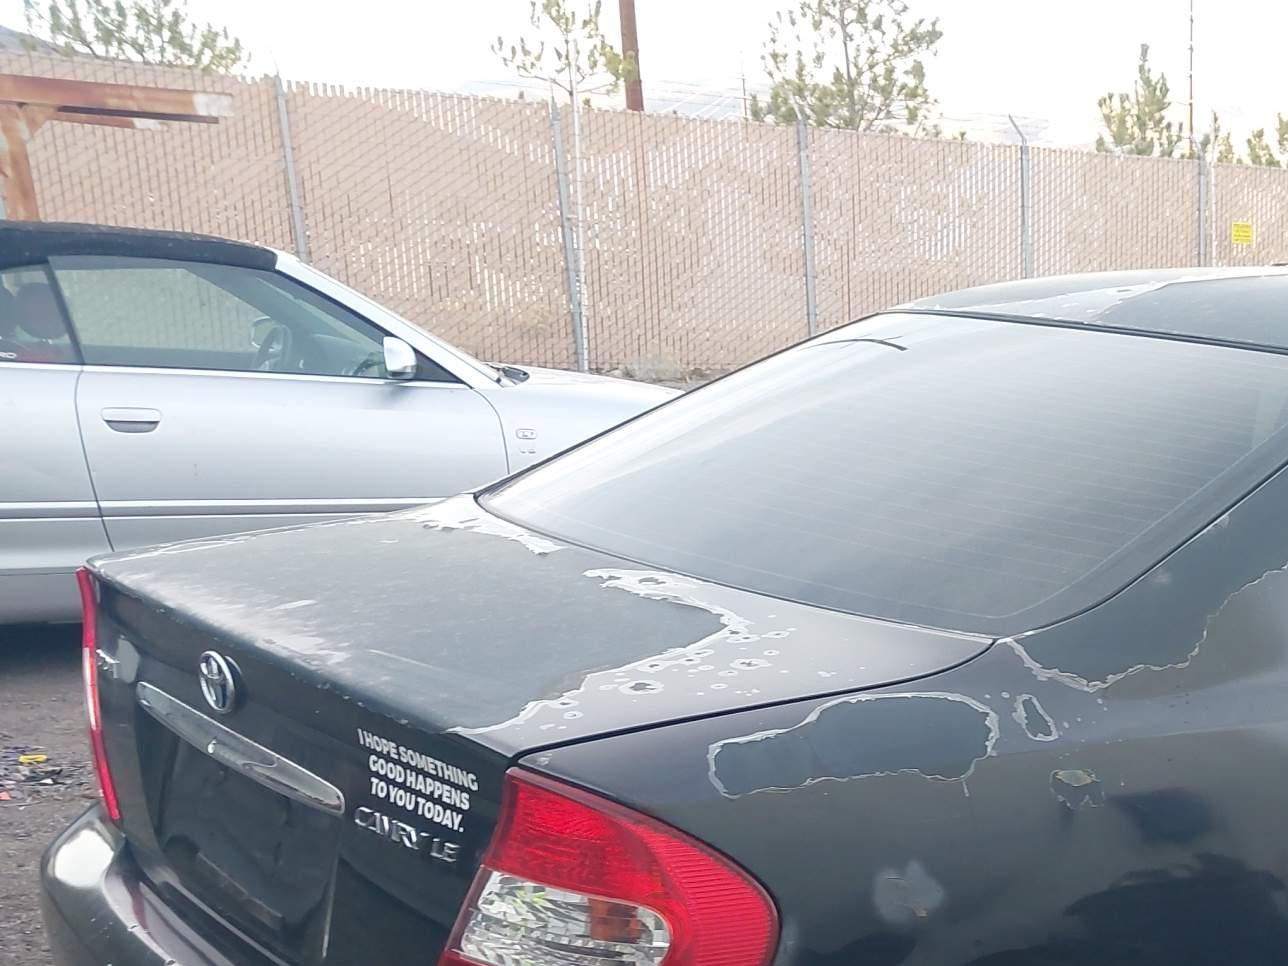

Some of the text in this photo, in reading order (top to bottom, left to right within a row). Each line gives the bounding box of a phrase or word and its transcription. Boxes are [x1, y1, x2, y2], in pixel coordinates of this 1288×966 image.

[358, 728, 478, 791] I HOPE SOMETHING
[369, 755, 469, 810] GOOD HAPPENS
[370, 777, 464, 832] TO YOU TODAY.
[430, 838, 461, 862] LE
